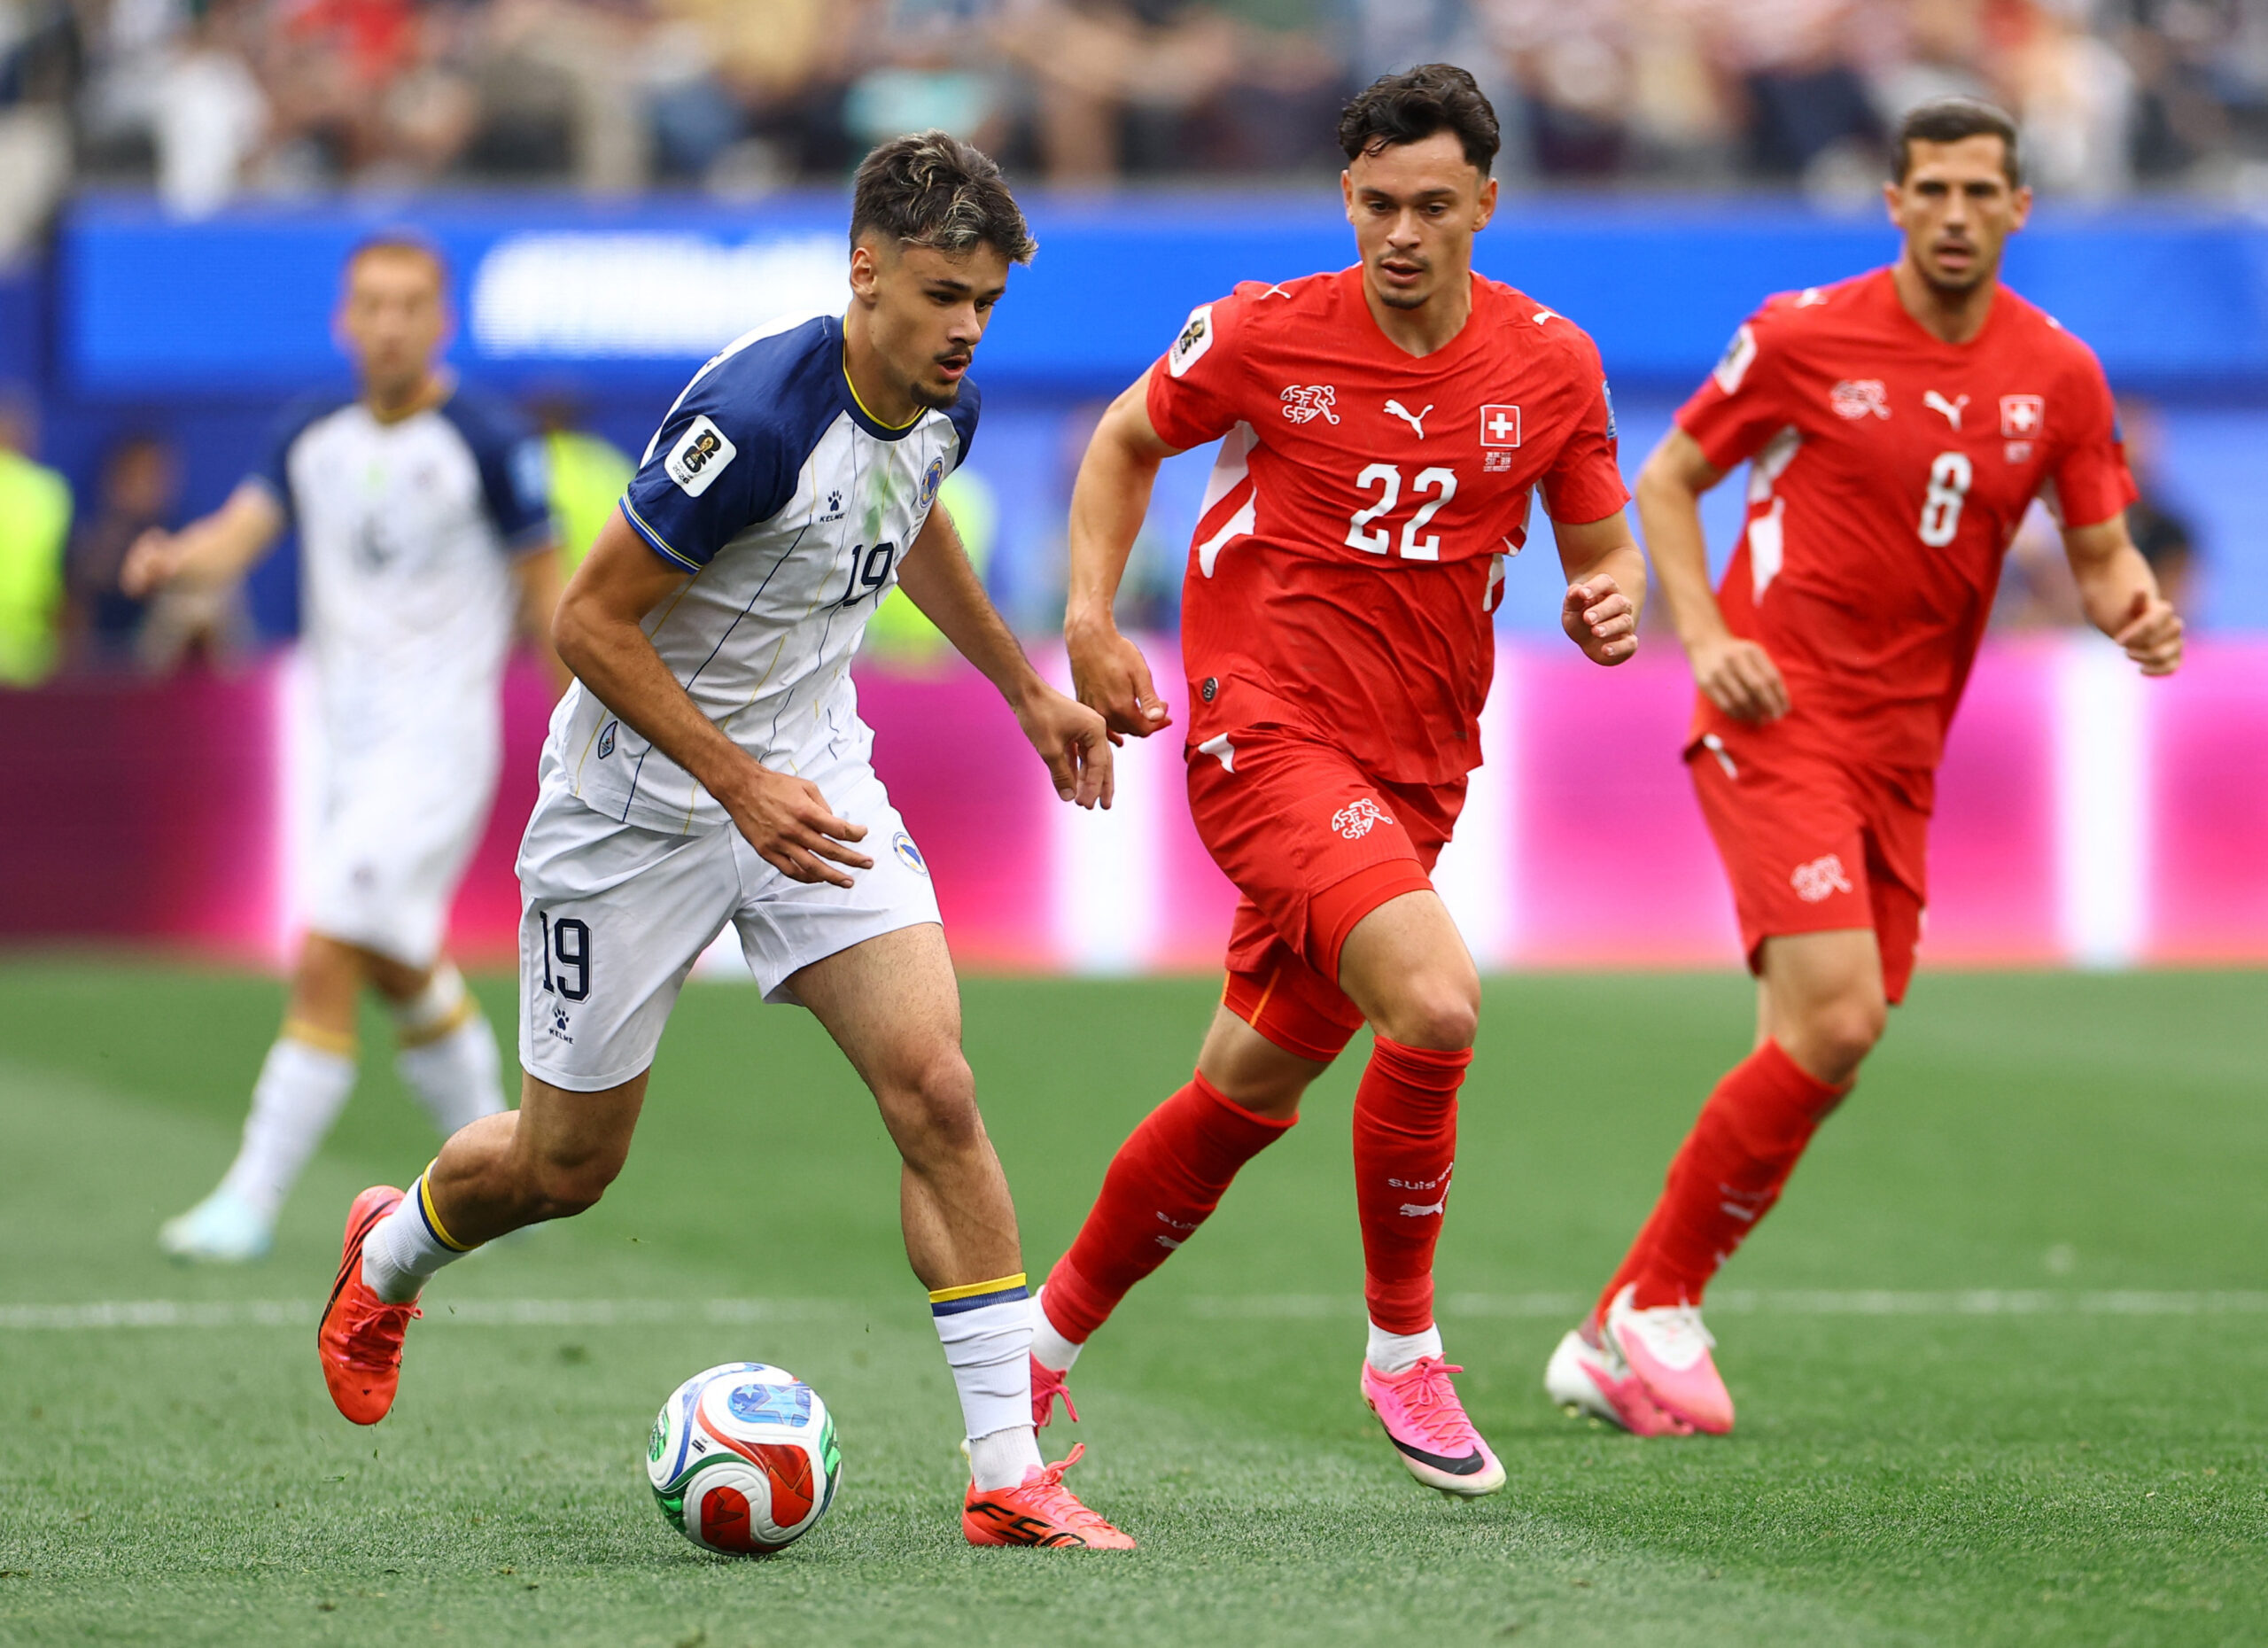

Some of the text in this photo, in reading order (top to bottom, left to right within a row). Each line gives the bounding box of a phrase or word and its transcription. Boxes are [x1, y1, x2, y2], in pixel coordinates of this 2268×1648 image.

[819, 512, 845, 523] KELME
[1344, 463, 1458, 561] 22
[1917, 452, 1972, 548] 8
[843, 541, 895, 609] 19
[540, 910, 592, 1005] 19
[548, 1028, 574, 1045] KELME
